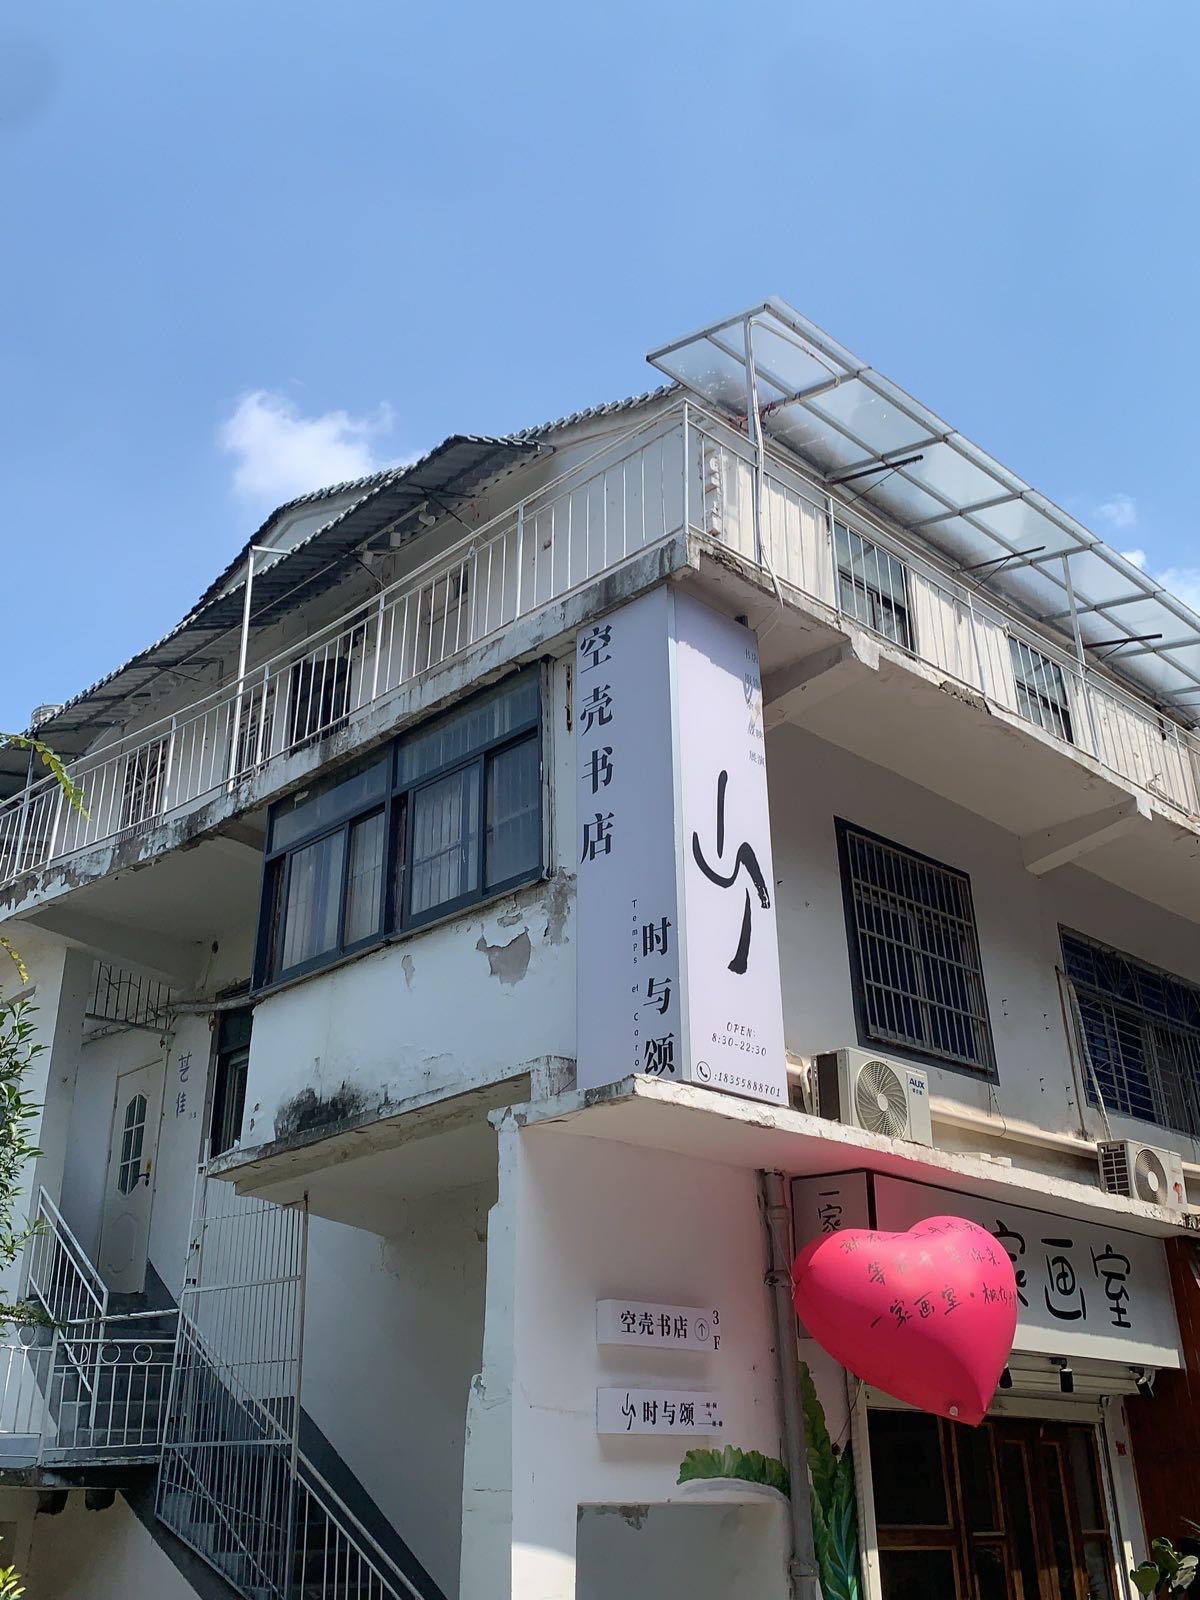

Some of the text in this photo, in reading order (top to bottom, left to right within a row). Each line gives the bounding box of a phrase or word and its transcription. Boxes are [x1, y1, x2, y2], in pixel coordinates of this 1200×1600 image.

[580, 624, 615, 864] 空壳书店
[642, 916, 675, 1076] 时与颂
[726, 1021, 757, 1038] OPEN:
[711, 1032, 767, 1057] 8:30-22:30
[909, 1077, 925, 1090] AUX
[620, 1310, 688, 1339] 空壳书店
[642, 1400, 695, 1426] 时与颂
